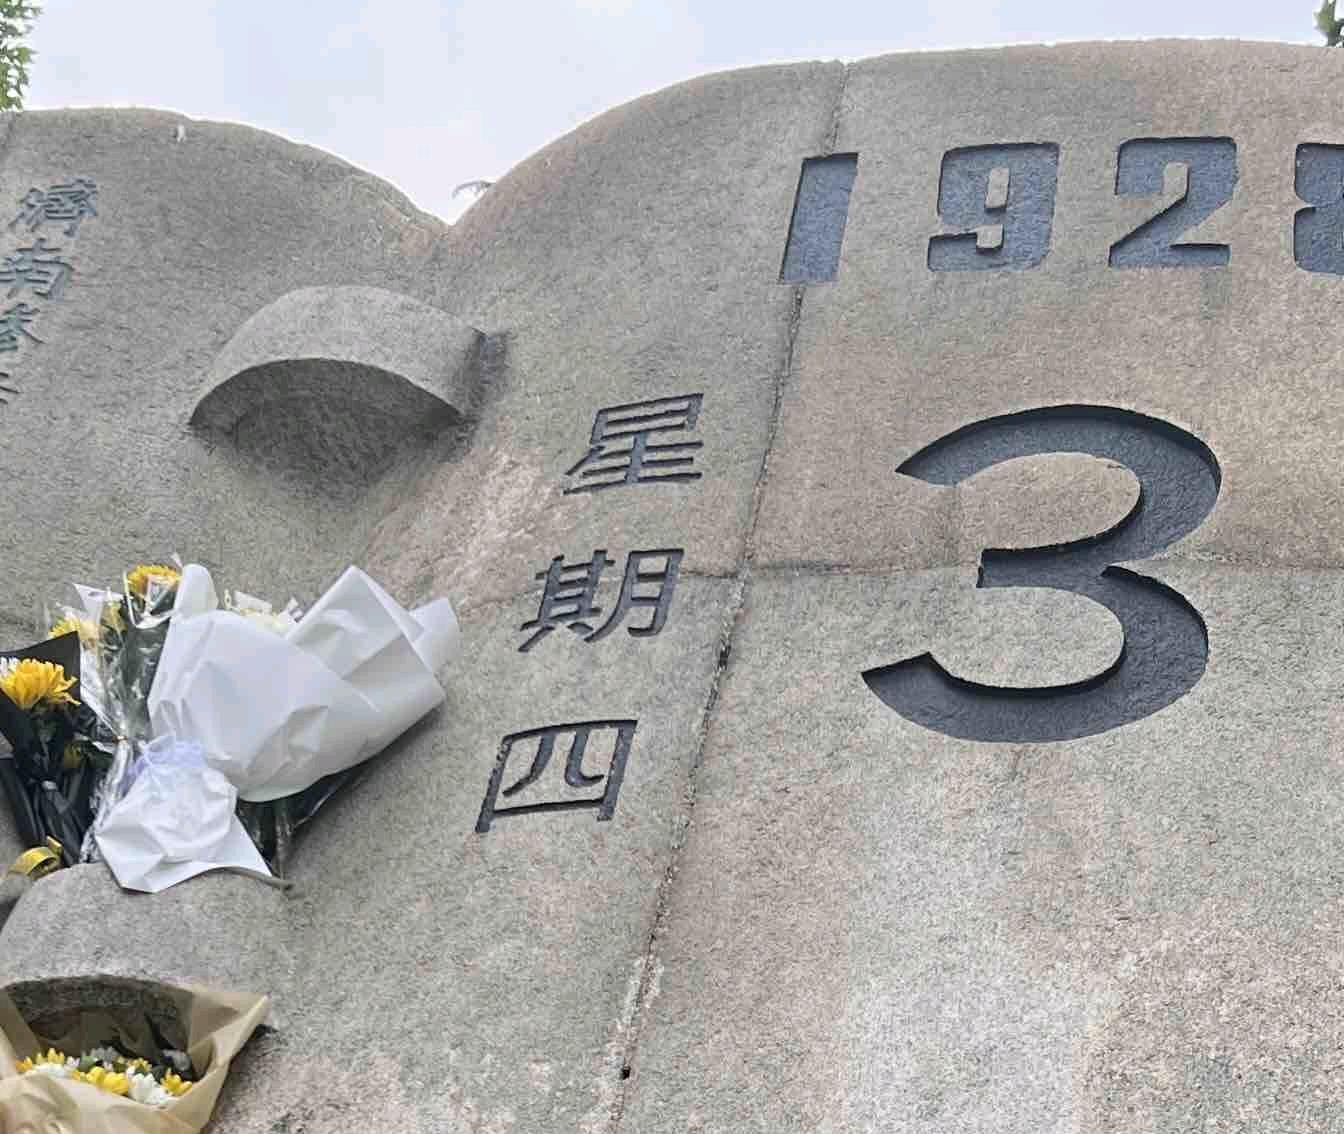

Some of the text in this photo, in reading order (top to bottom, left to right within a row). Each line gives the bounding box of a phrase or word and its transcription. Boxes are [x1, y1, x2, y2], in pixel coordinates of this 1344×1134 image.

[475, 393, 704, 834] 星期四
[861, 403, 1222, 743] 3
